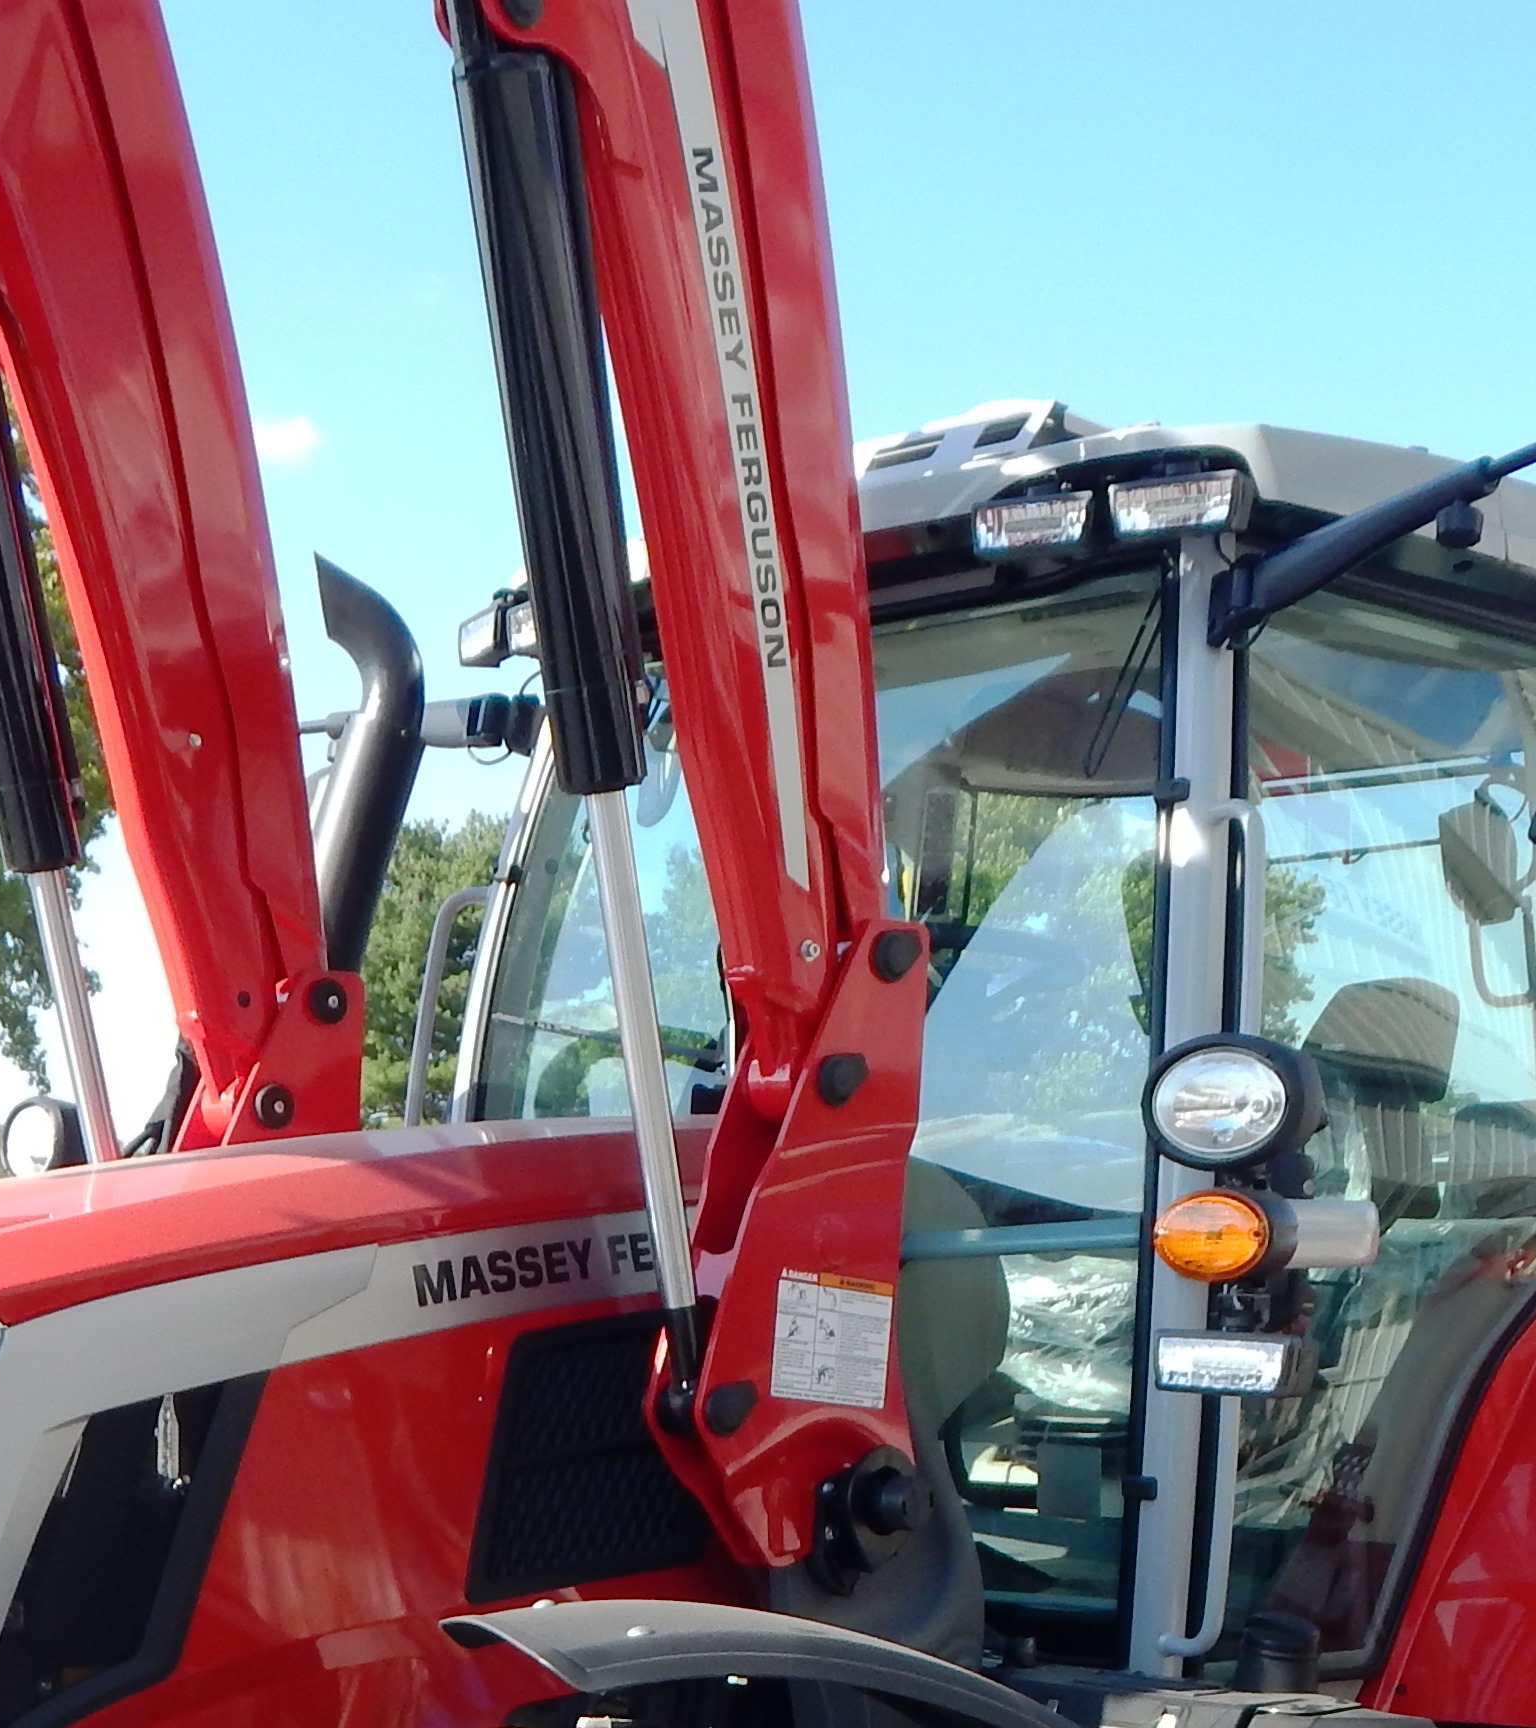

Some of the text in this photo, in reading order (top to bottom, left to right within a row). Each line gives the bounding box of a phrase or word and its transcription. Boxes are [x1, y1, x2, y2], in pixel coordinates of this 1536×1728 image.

[690, 146, 788, 669] MASSEY FERGUSON
[412, 1238, 592, 1307] MASSEY
